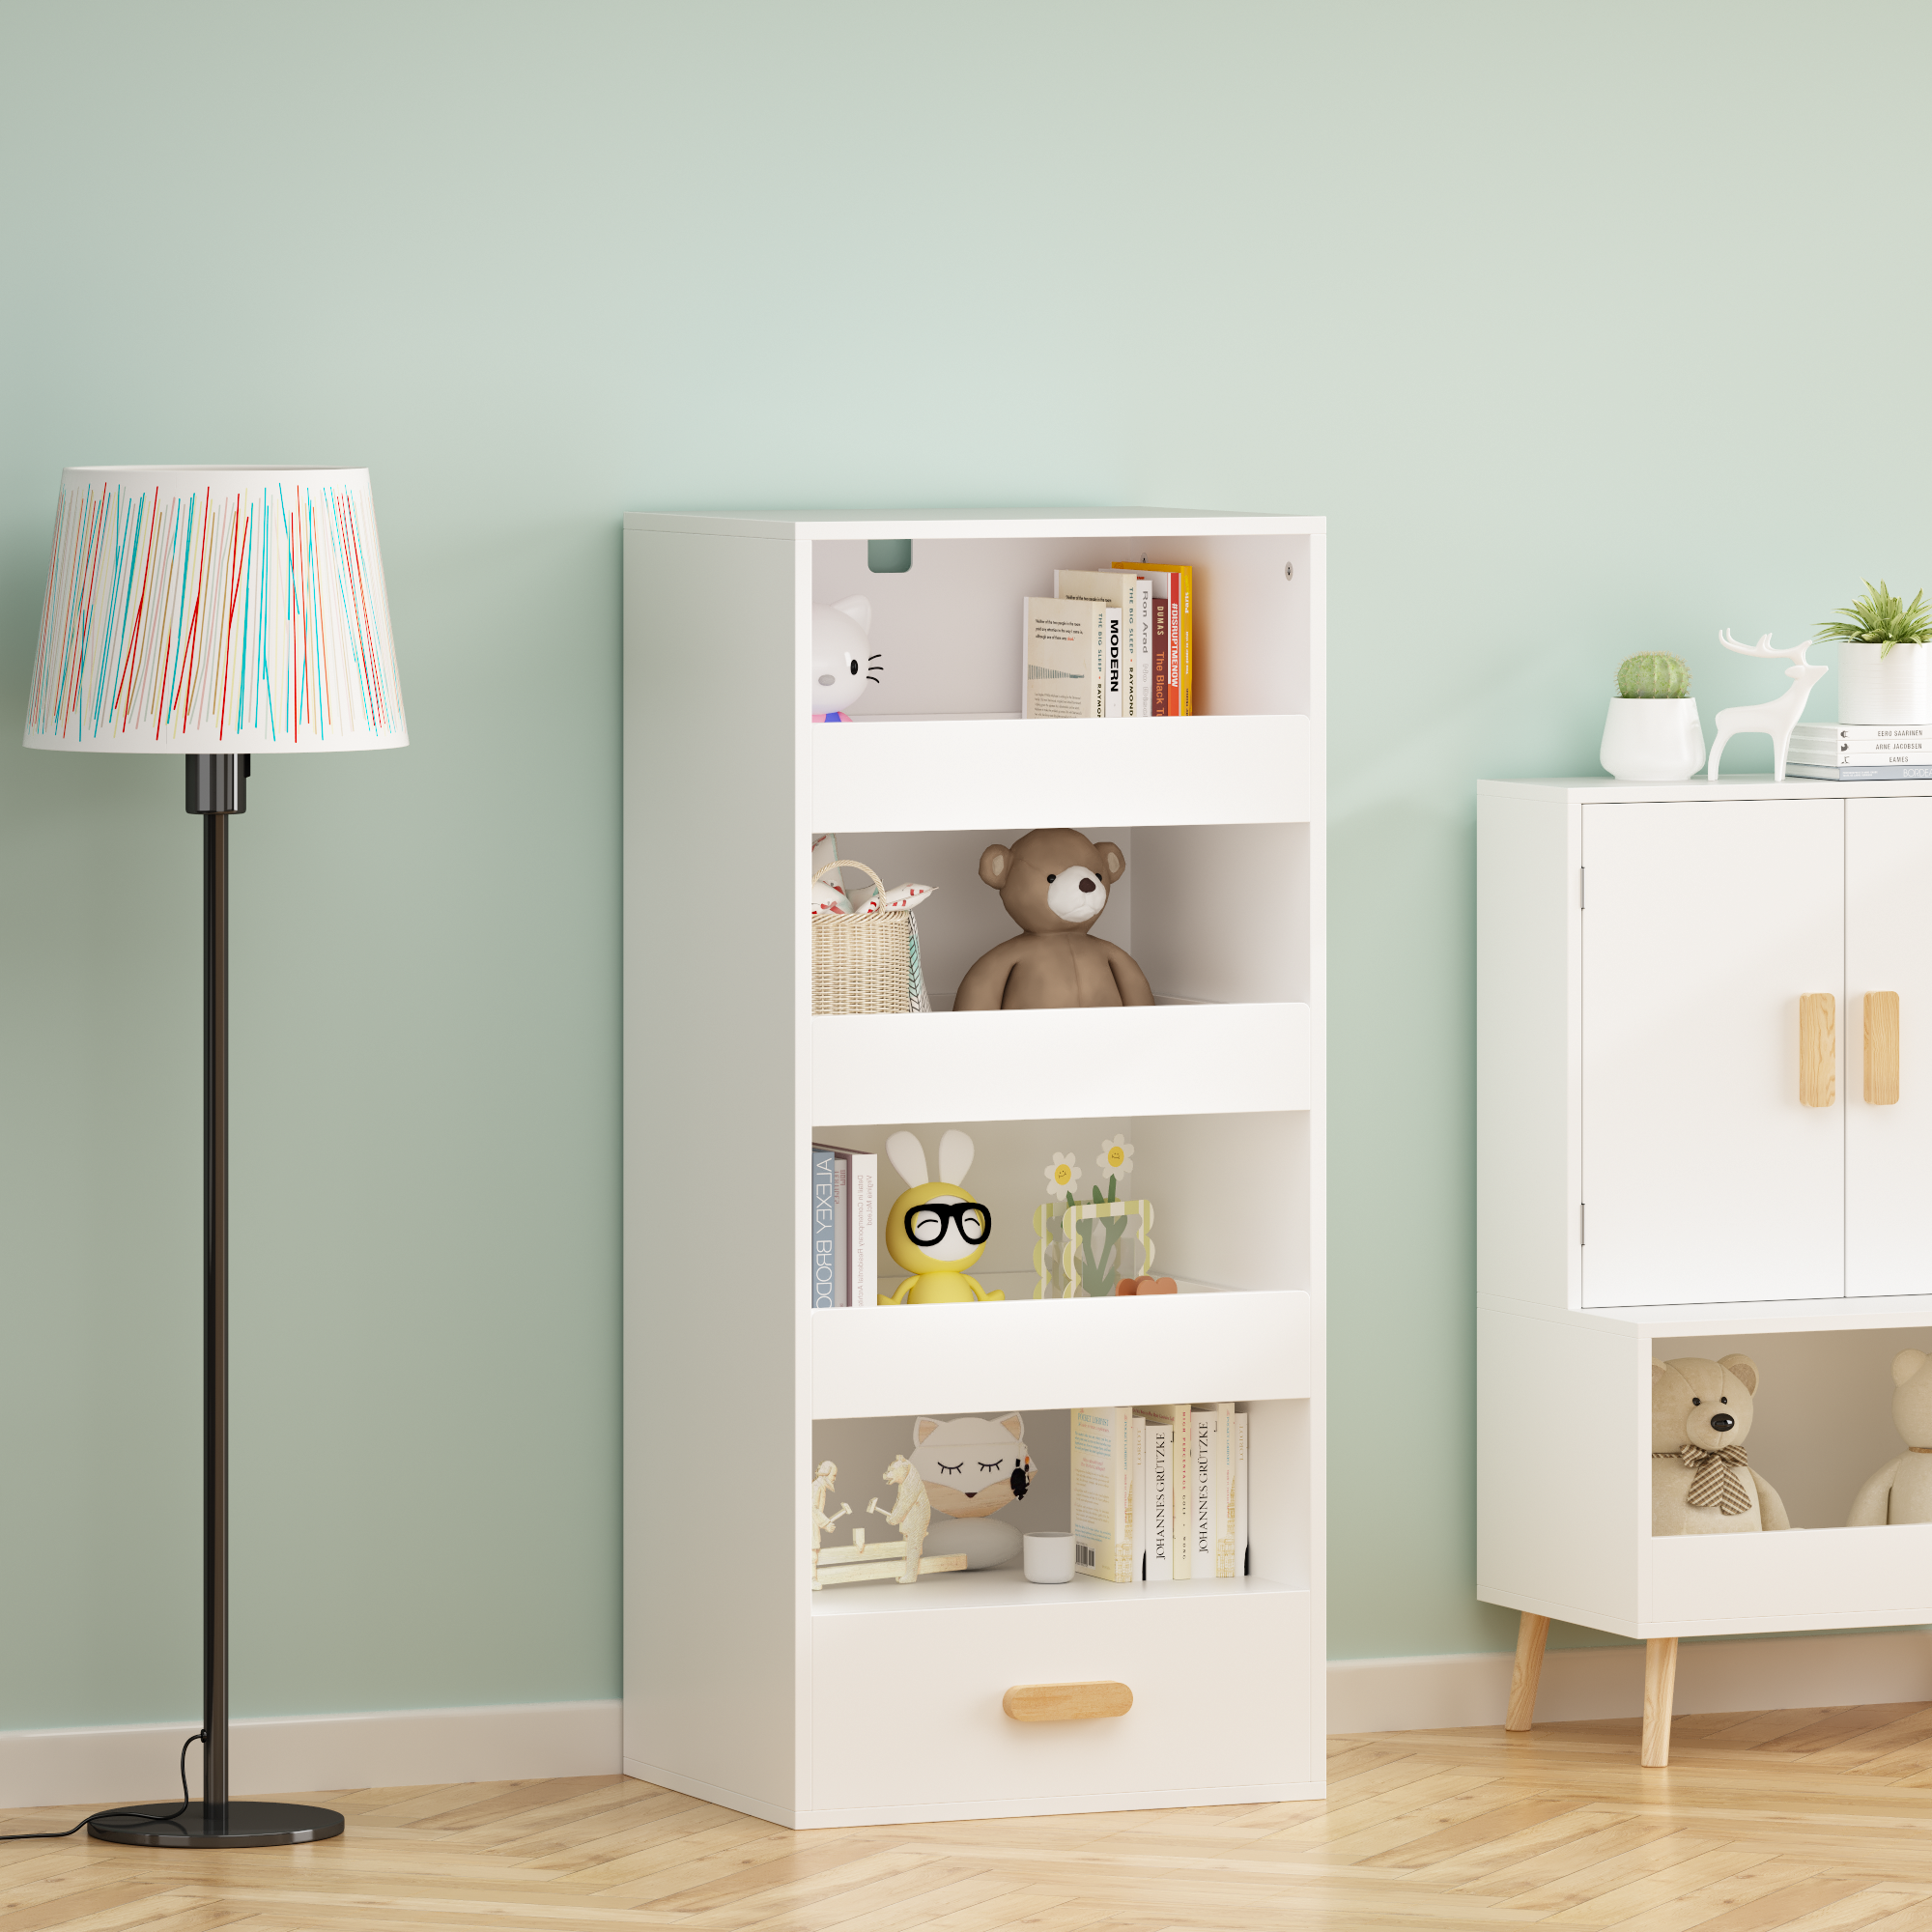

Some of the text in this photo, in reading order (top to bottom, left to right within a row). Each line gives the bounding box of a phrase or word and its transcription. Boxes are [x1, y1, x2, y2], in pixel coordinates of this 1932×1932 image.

[1156, 675, 1165, 704] Black
[1155, 1433, 1166, 1560] JOHANNES GRÜTZKE
[1198, 1422, 1208, 1553] JOHANNES GRÜTZKE
